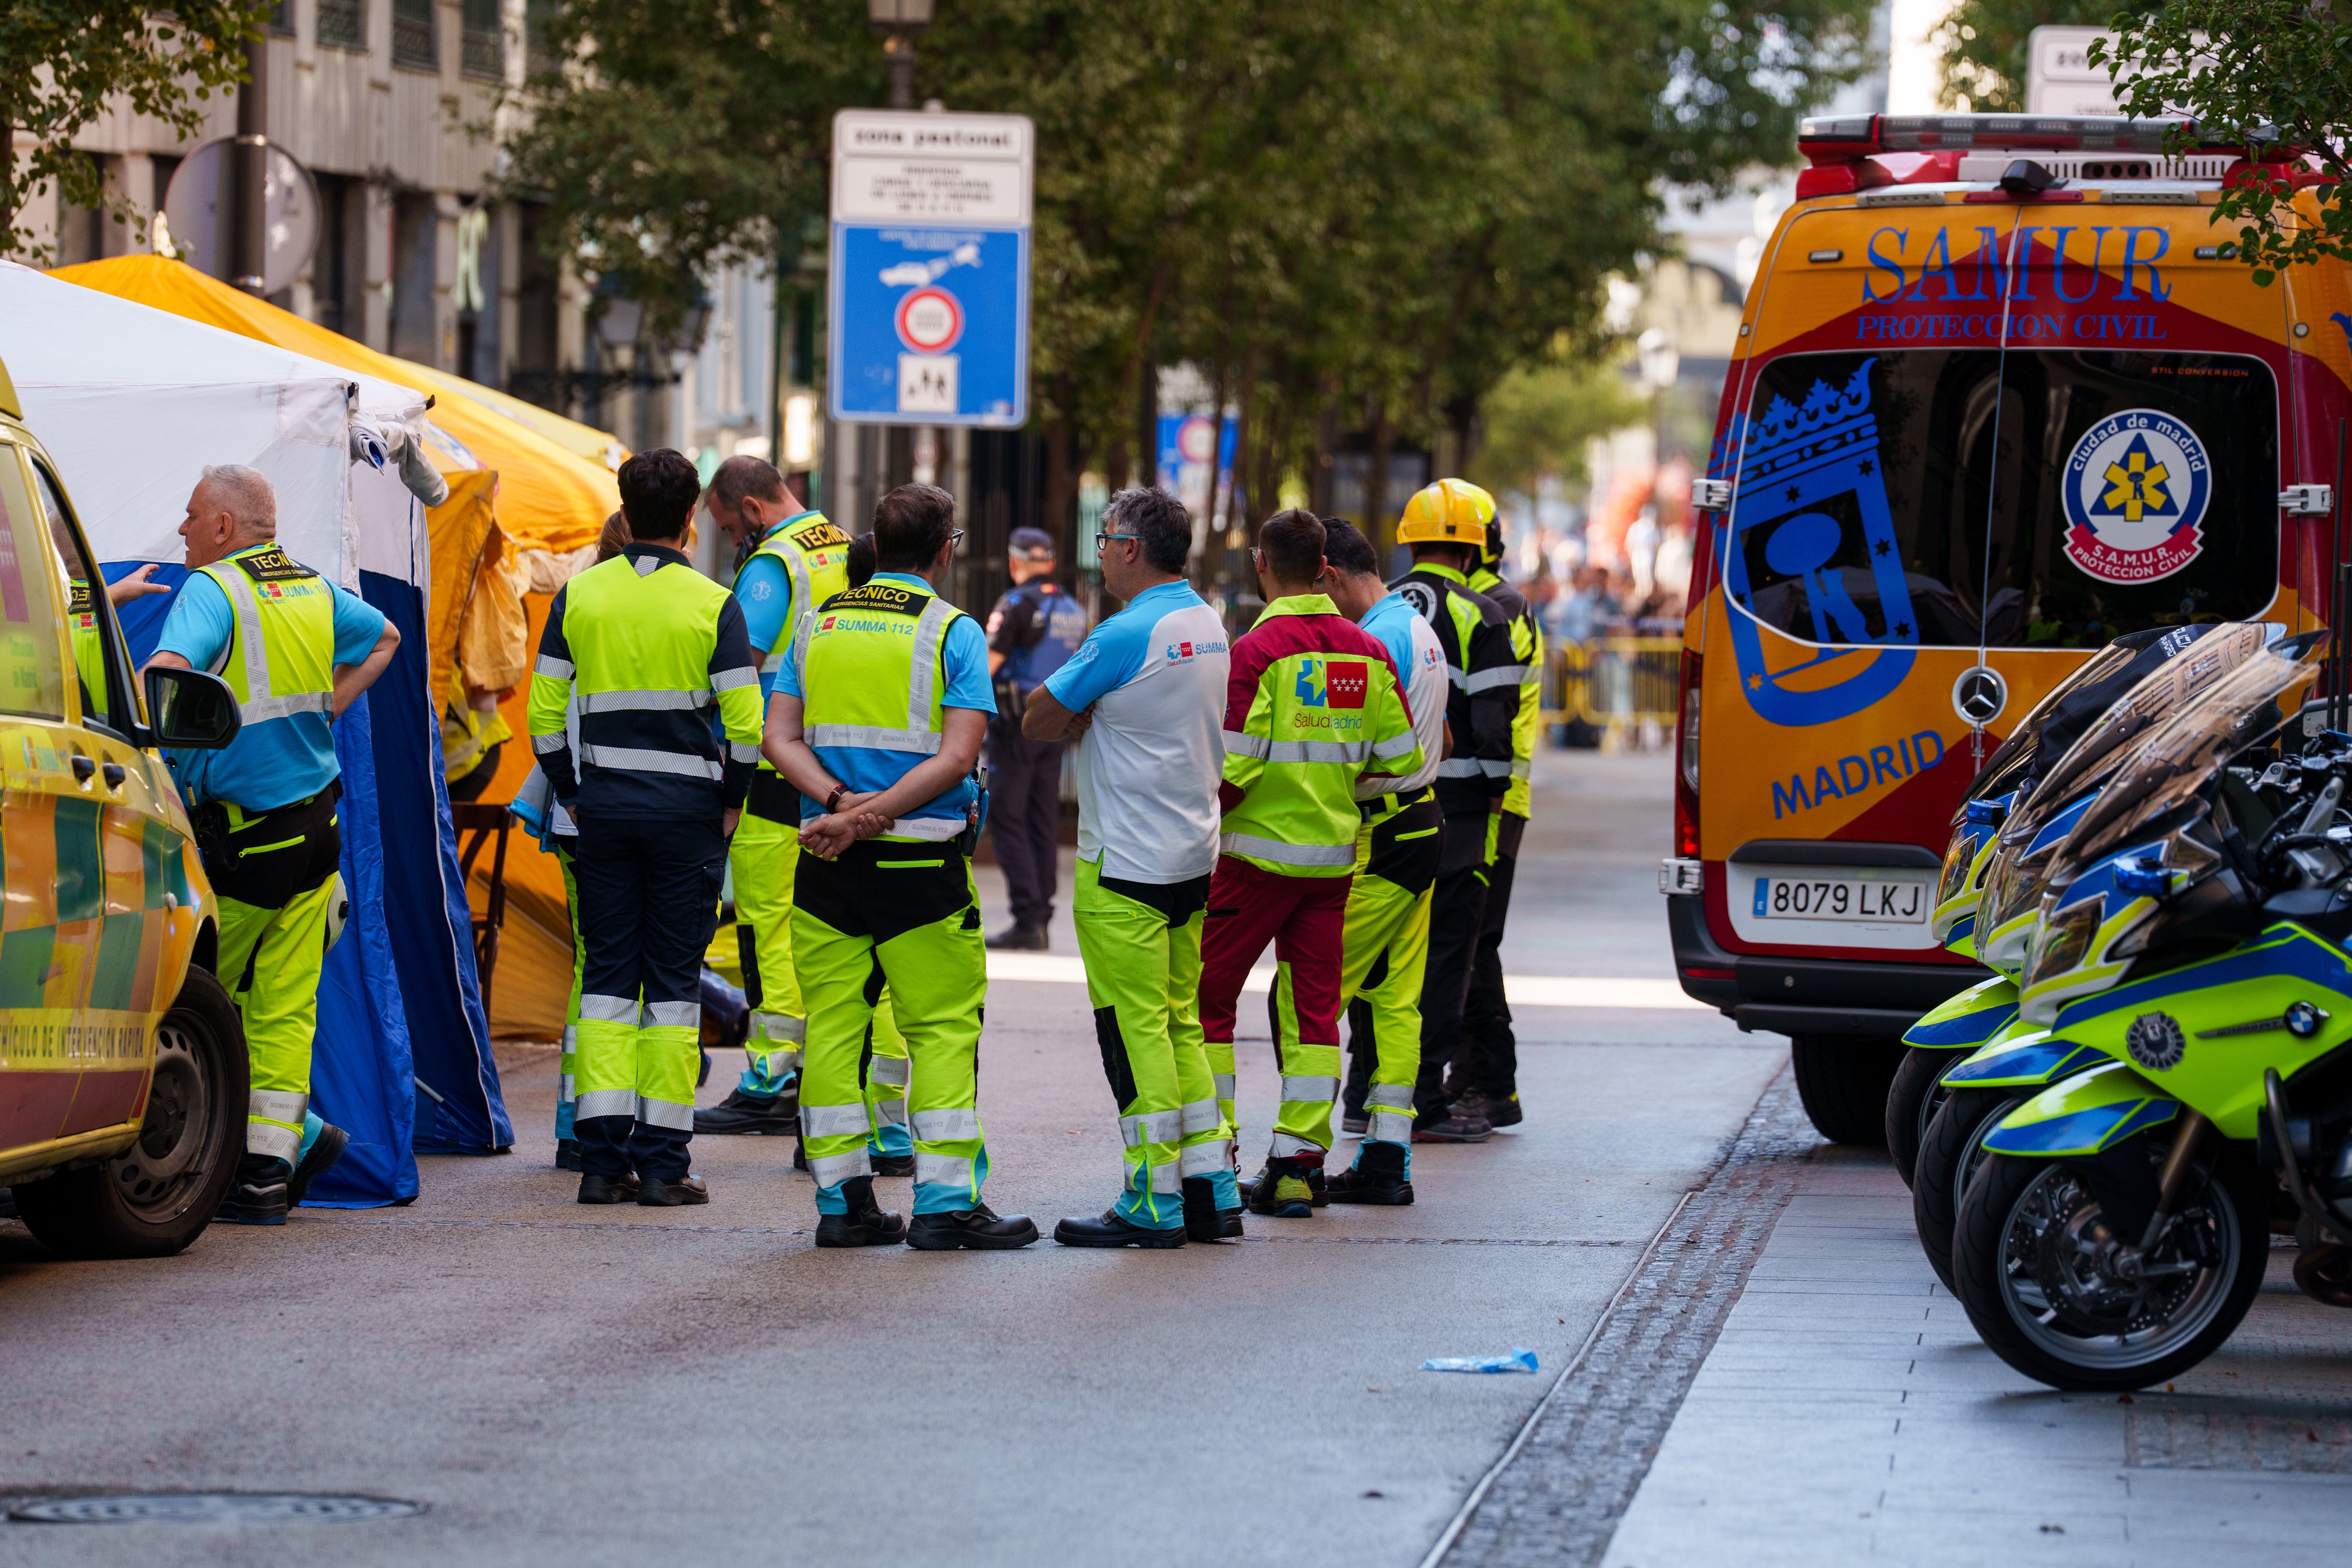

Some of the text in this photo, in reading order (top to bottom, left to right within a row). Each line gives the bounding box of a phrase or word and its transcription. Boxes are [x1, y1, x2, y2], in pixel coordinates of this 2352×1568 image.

[1862, 225, 2173, 305] SAMUR
[1856, 314, 2167, 340] PROTECCION CIVIL
[2151, 366, 2249, 377] STIL CONVERSION
[2073, 413, 2206, 473] ciudad de madrid
[2073, 547, 2192, 578] PROTECCION CIVIL
[2092, 544, 2173, 566] S.A.M.U.R.
[837, 586, 910, 603] TECNICO
[868, 601, 905, 610] SANITARIAS
[836, 619, 914, 636] SUMMA 112
[249, 642, 259, 667] SUMMA
[1195, 641, 1228, 655] SUMMA
[881, 735, 906, 743] SUMMA
[1771, 729, 1945, 820] MADRID
[911, 823, 937, 833] SUMMA
[1773, 882, 1920, 917] 8079 LKJ
[42, 1025, 52, 1058] DE
